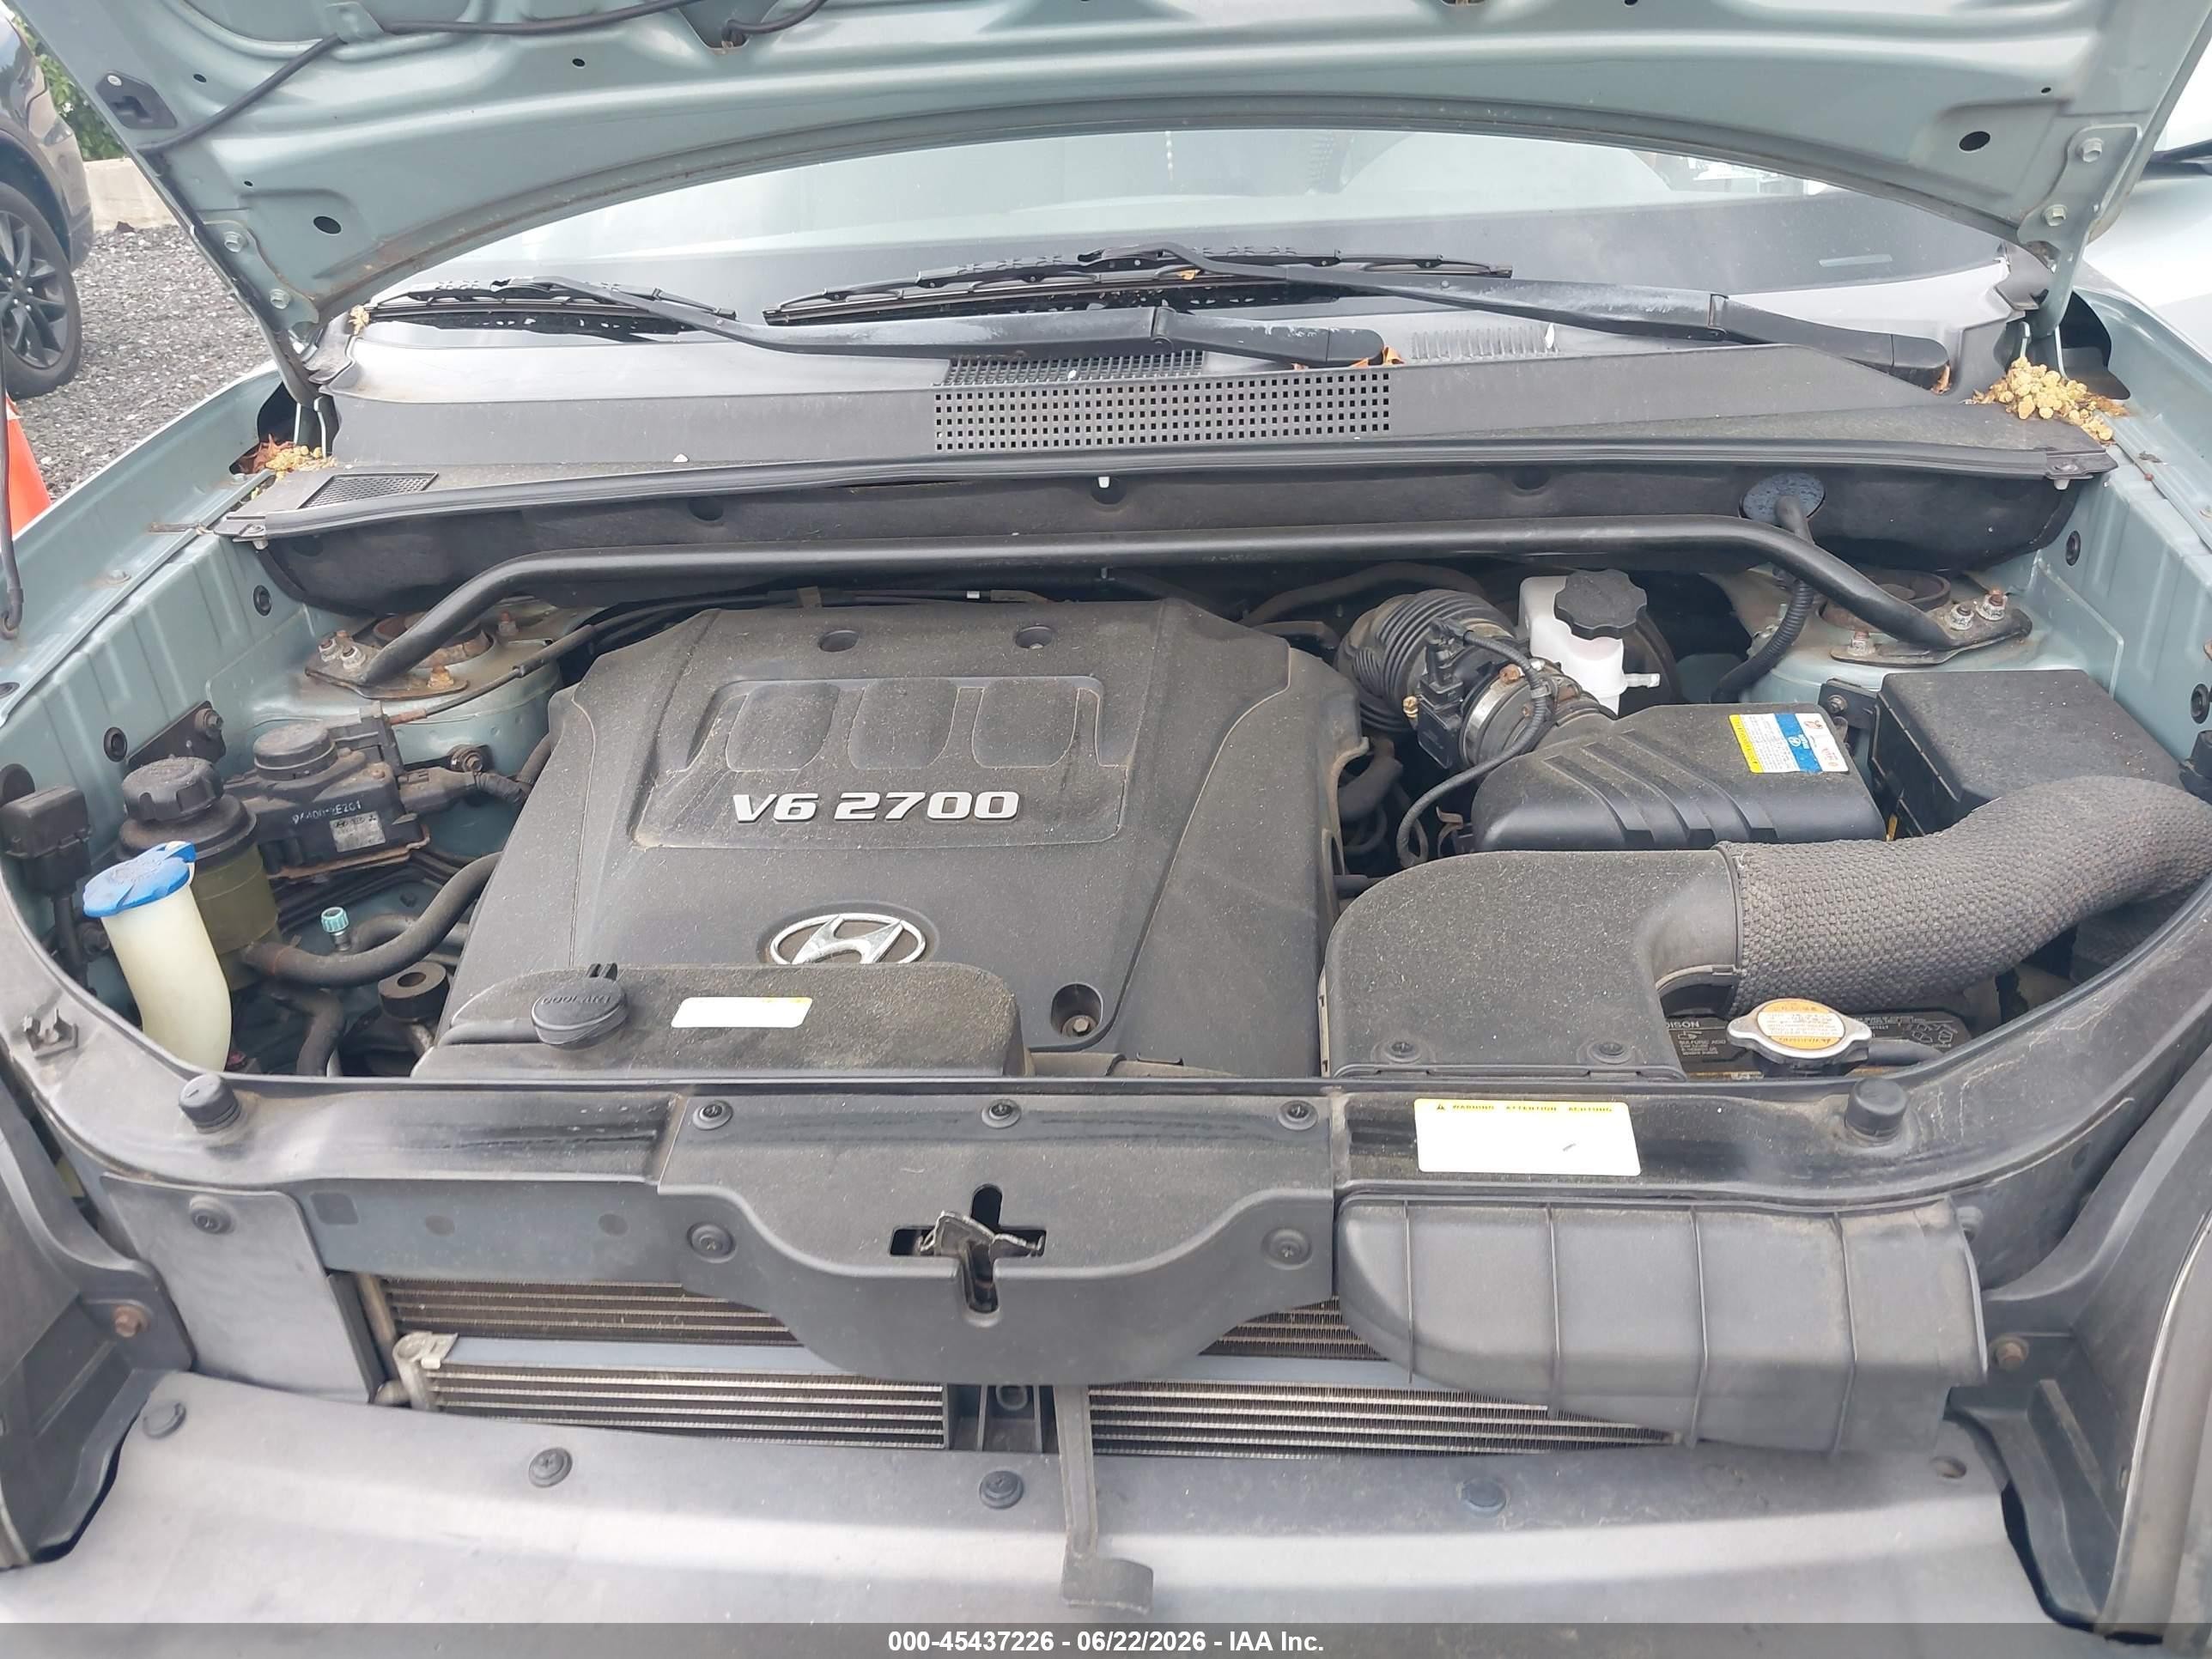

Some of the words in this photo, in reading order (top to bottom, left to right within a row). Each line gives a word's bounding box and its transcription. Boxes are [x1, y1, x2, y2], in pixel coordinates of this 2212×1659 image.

[732, 793, 819, 823] V6
[834, 790, 1020, 822] 2700
[541, 995, 612, 1004] COOLANT
